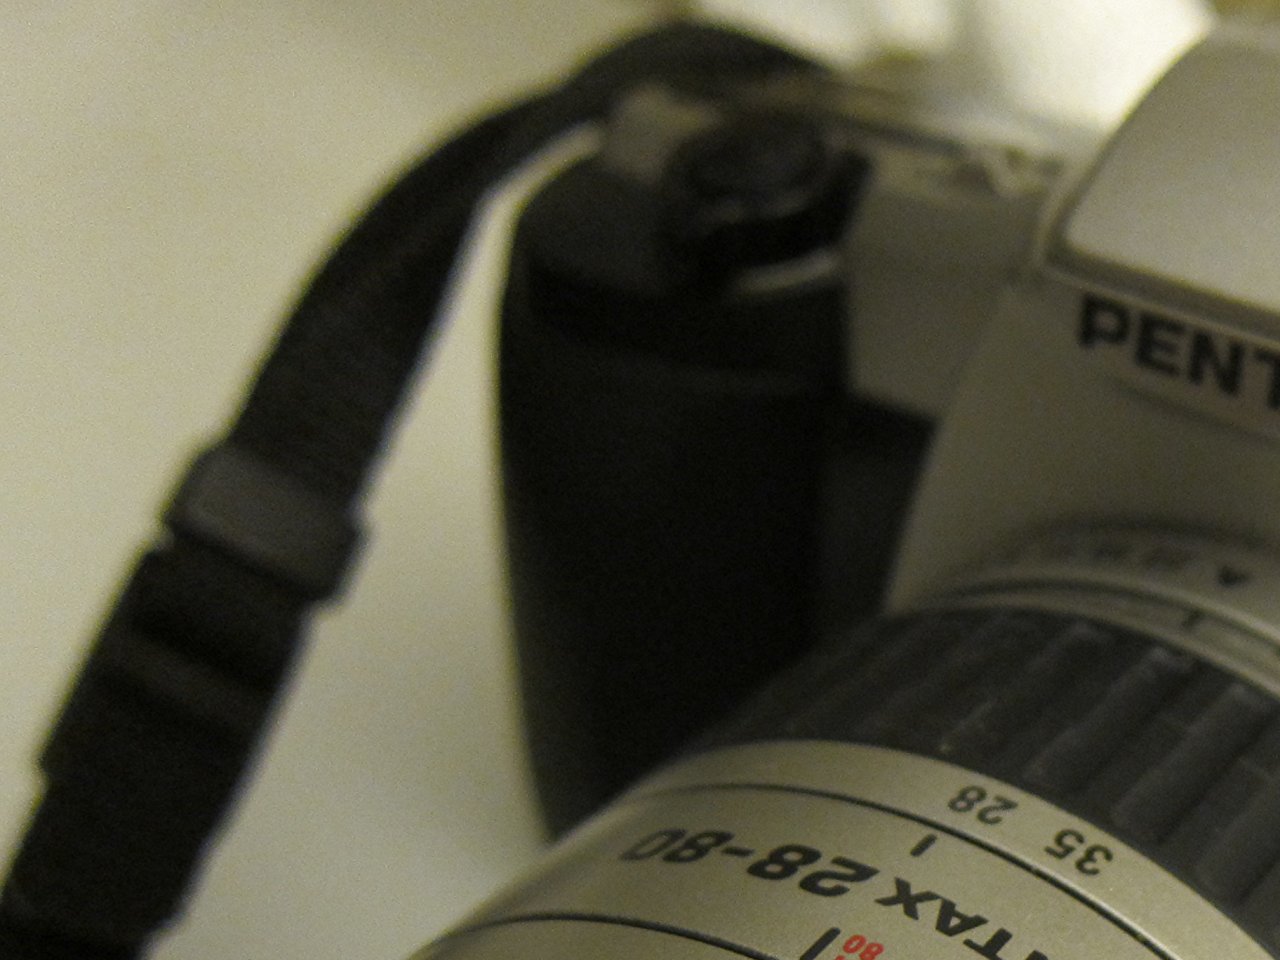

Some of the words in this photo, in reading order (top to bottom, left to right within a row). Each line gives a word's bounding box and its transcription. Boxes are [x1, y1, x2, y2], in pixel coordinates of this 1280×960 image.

[947, 784, 1019, 826] 28
[619, 828, 880, 897] 28-80
[1044, 828, 1113, 876] 35
